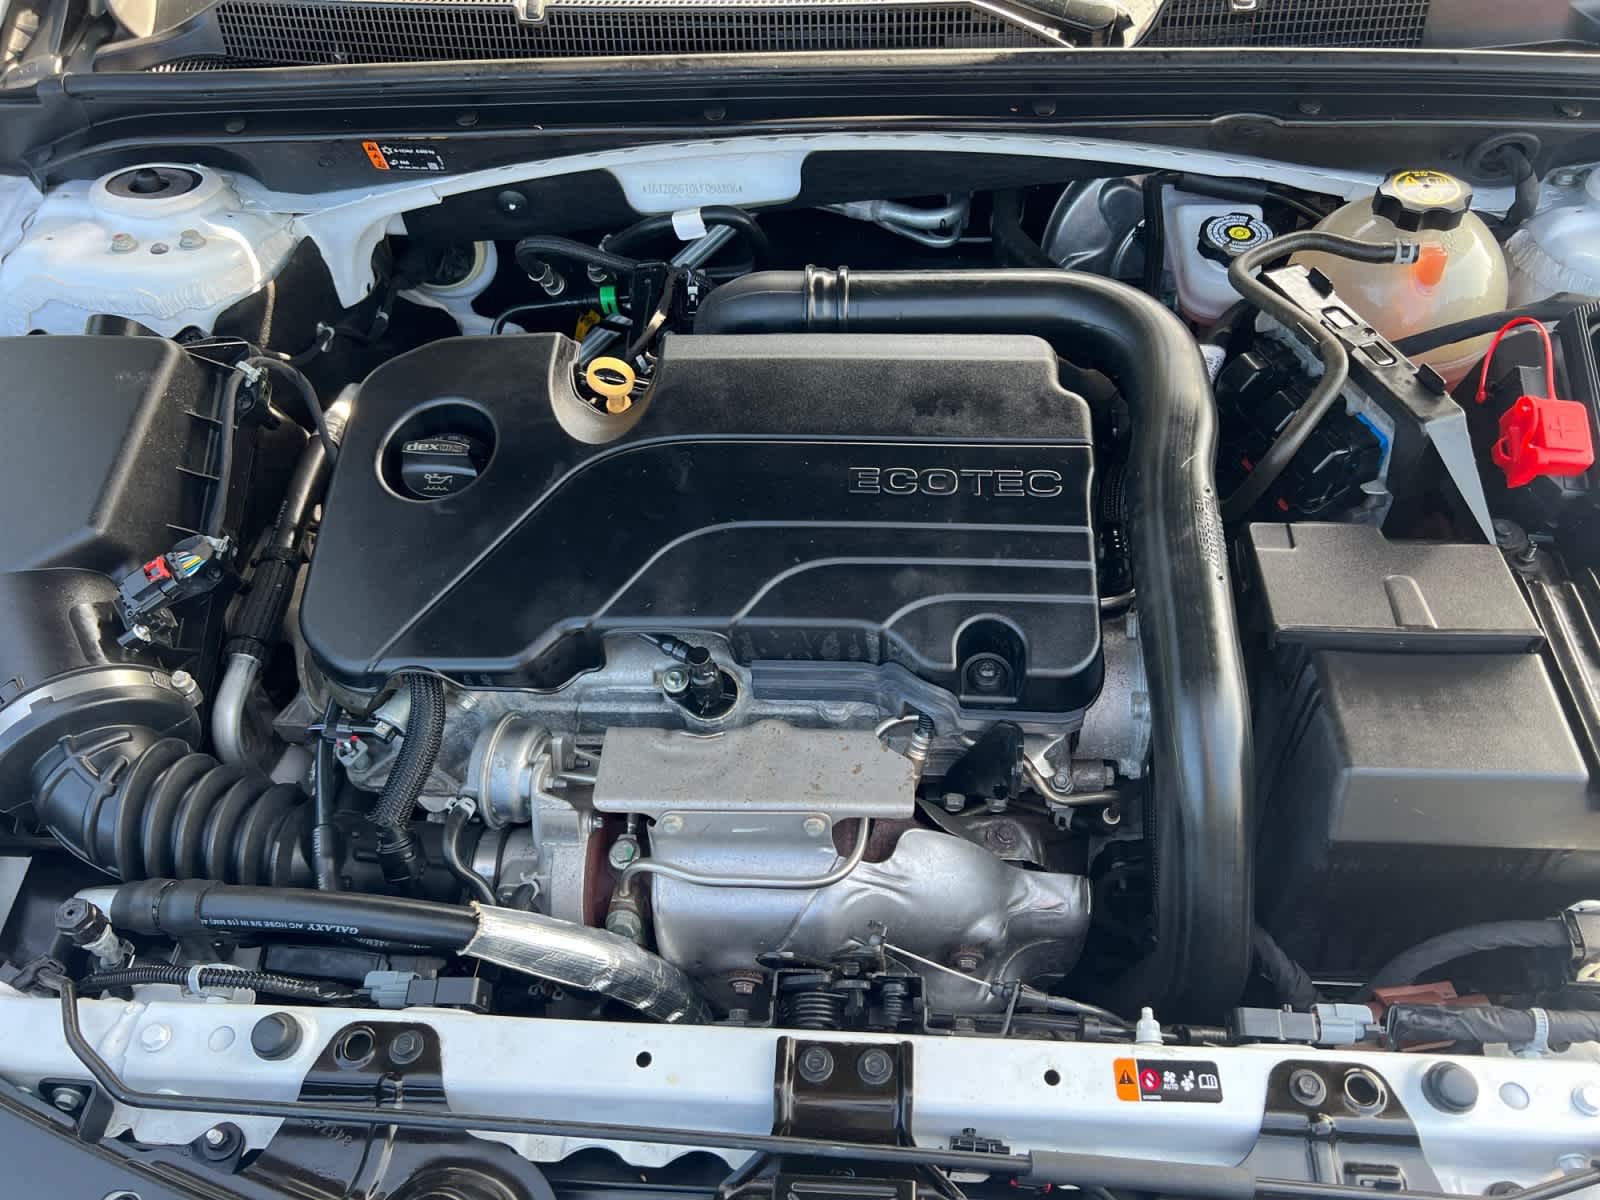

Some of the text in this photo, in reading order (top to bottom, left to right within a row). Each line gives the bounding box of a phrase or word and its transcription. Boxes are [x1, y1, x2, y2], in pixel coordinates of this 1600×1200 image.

[848, 467, 1064, 498] ECOTEC
[307, 923, 360, 935] GALAXY
[1163, 1083, 1179, 1091] AUTO
